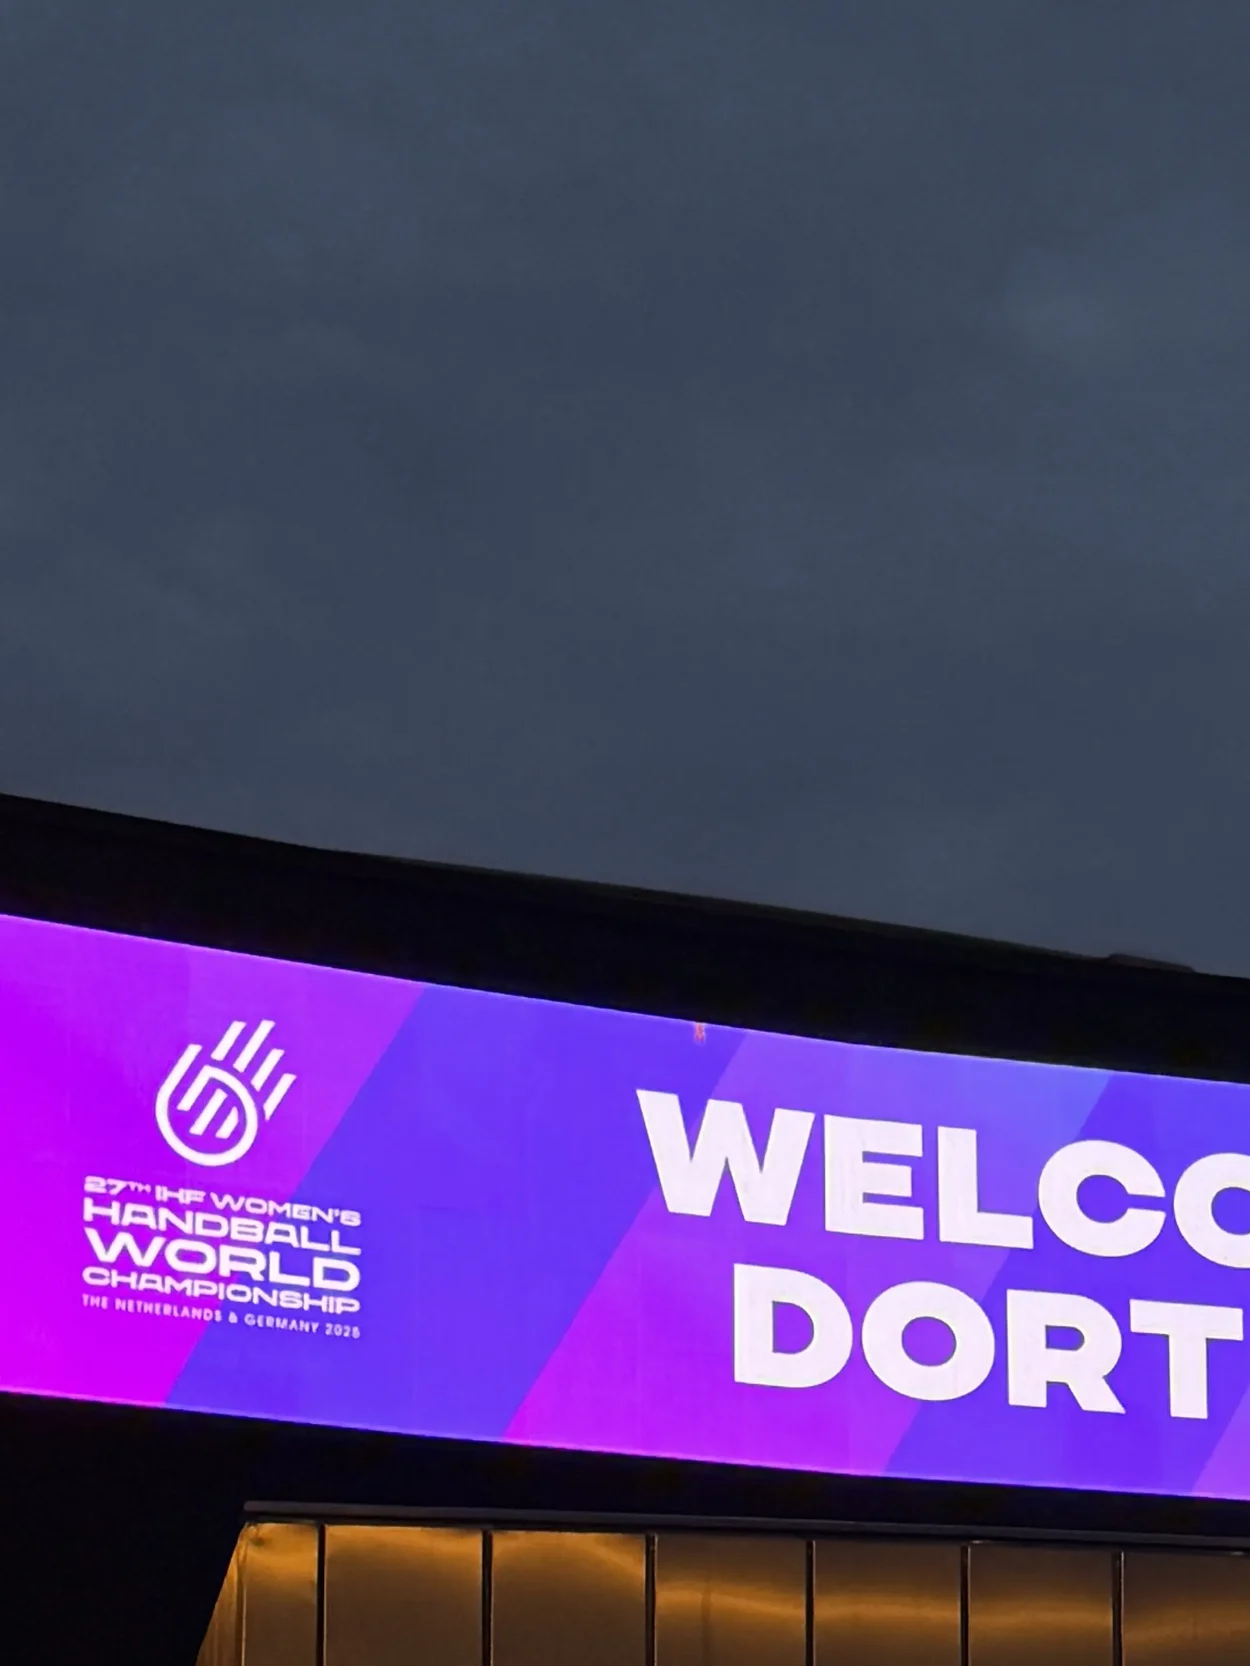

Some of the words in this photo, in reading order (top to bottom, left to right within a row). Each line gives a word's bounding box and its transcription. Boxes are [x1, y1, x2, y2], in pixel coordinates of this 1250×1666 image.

[83, 1197, 362, 1256] HANDBALL
[84, 1175, 151, 1195] 27TH
[155, 1185, 206, 1205] IHF
[210, 1191, 361, 1227] WOMEN'S
[84, 1227, 361, 1292] WORLD
[82, 1266, 361, 1315] CHAMPIONSHIP
[82, 1293, 108, 1310] THE
[115, 1298, 222, 1323] NETHERLANDS
[244, 1313, 320, 1334] GERMANY
